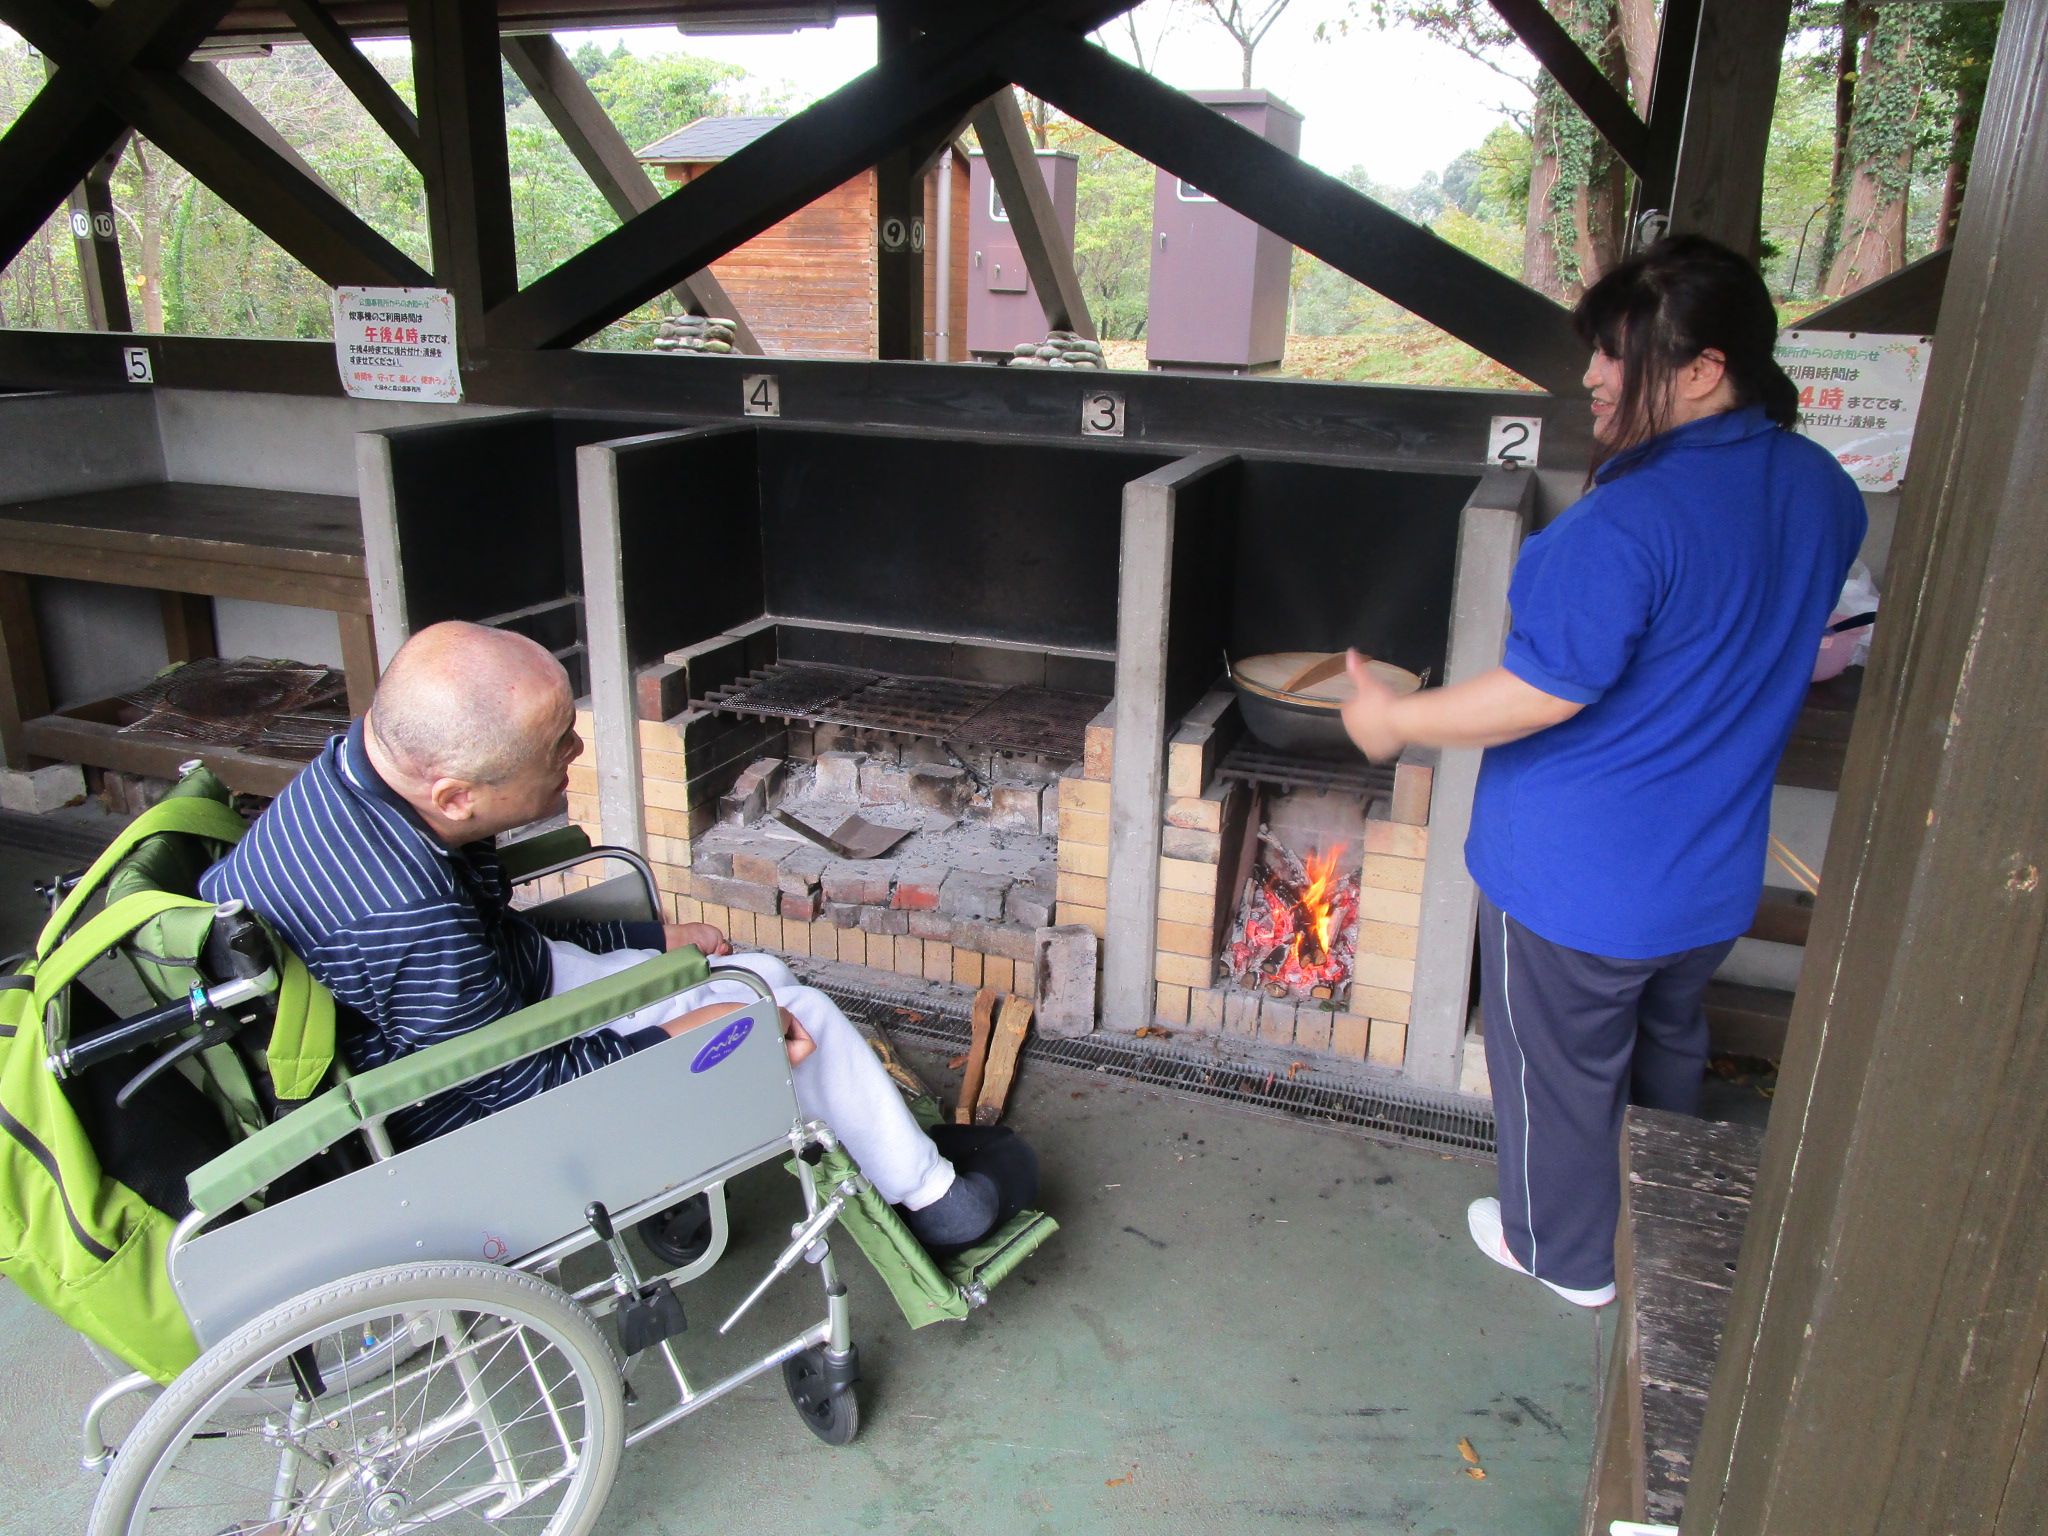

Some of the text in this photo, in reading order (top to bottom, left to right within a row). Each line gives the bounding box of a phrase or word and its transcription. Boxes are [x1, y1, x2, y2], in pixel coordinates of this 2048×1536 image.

[75, 217, 86, 231] 10
[96, 218, 109, 232] 10
[887, 225, 899, 242] 9
[914, 227, 921, 241] 9
[349, 311, 423, 323] 炊事棟のご利用時間は
[365, 326, 451, 345] 午後4時 までです。
[131, 351, 147, 378] 5
[350, 356, 403, 367] すませてください。
[354, 372, 373, 382] 時間を
[399, 374, 417, 383] 楽しく
[750, 379, 772, 412] 4
[1798, 386, 1907, 412] 4時 までです。
[1090, 395, 1116, 431] 3
[1498, 422, 1529, 461] 2
